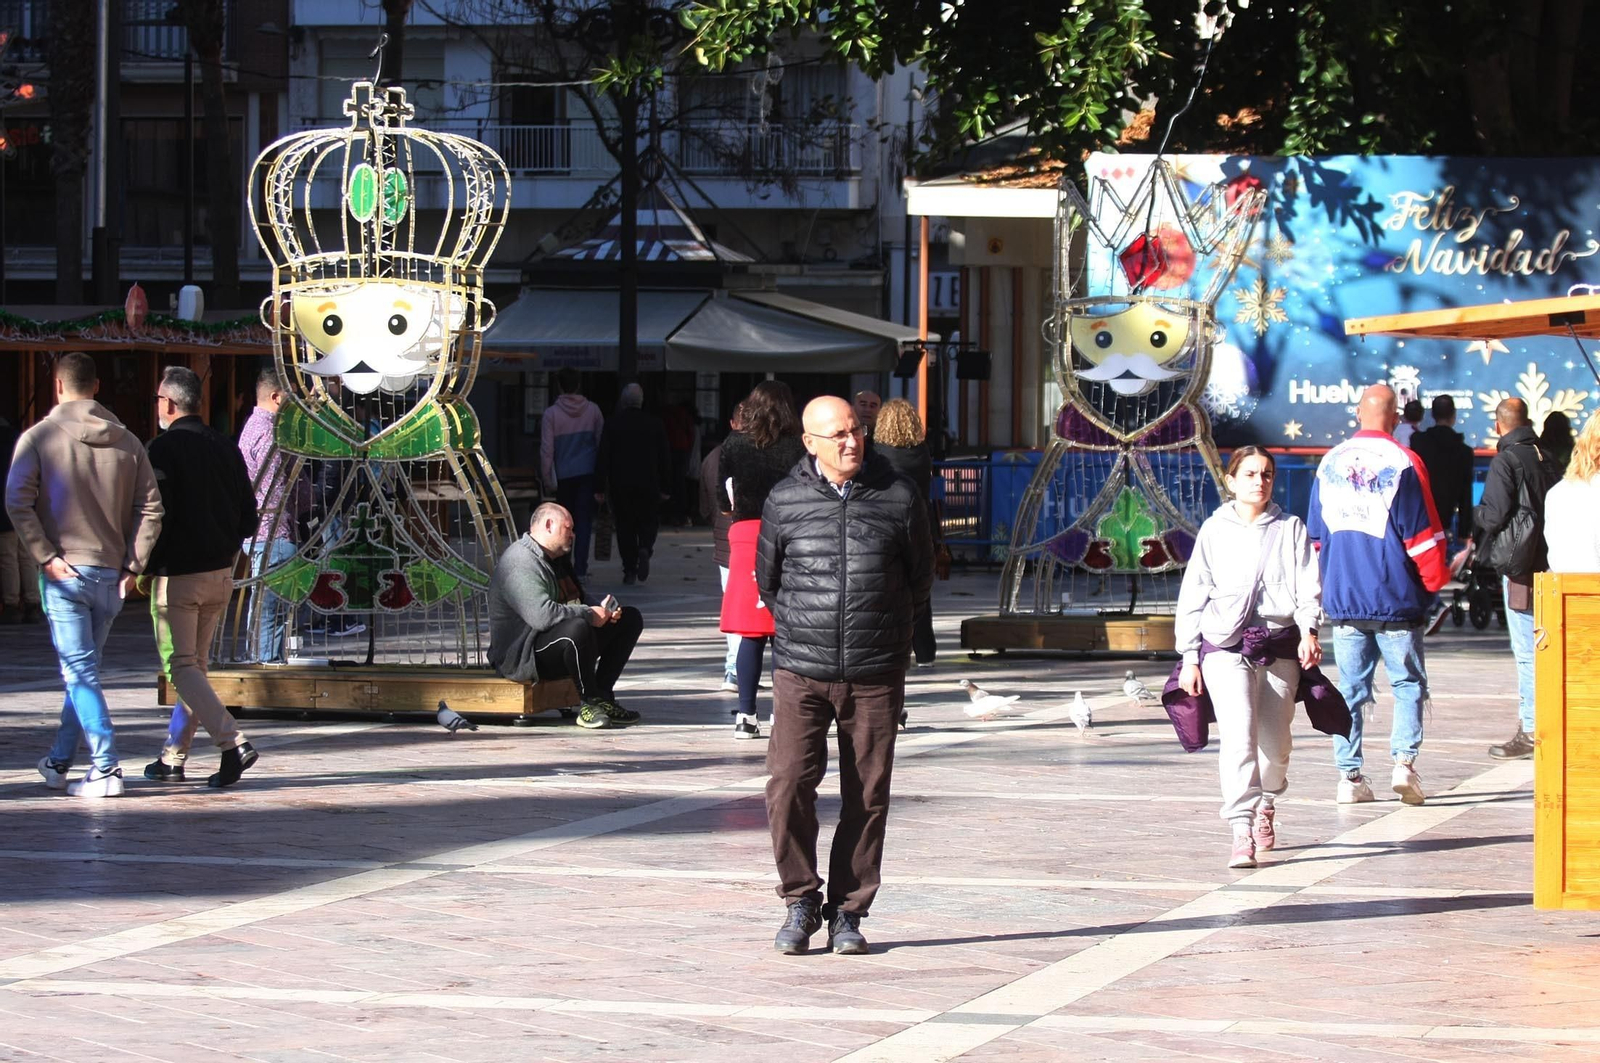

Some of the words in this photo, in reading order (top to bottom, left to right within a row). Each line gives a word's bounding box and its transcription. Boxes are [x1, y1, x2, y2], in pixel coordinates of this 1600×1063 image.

[1383, 185, 1519, 243] Feliz
[1385, 228, 1599, 276] Navidad
[1289, 379, 1387, 404] Huelv
